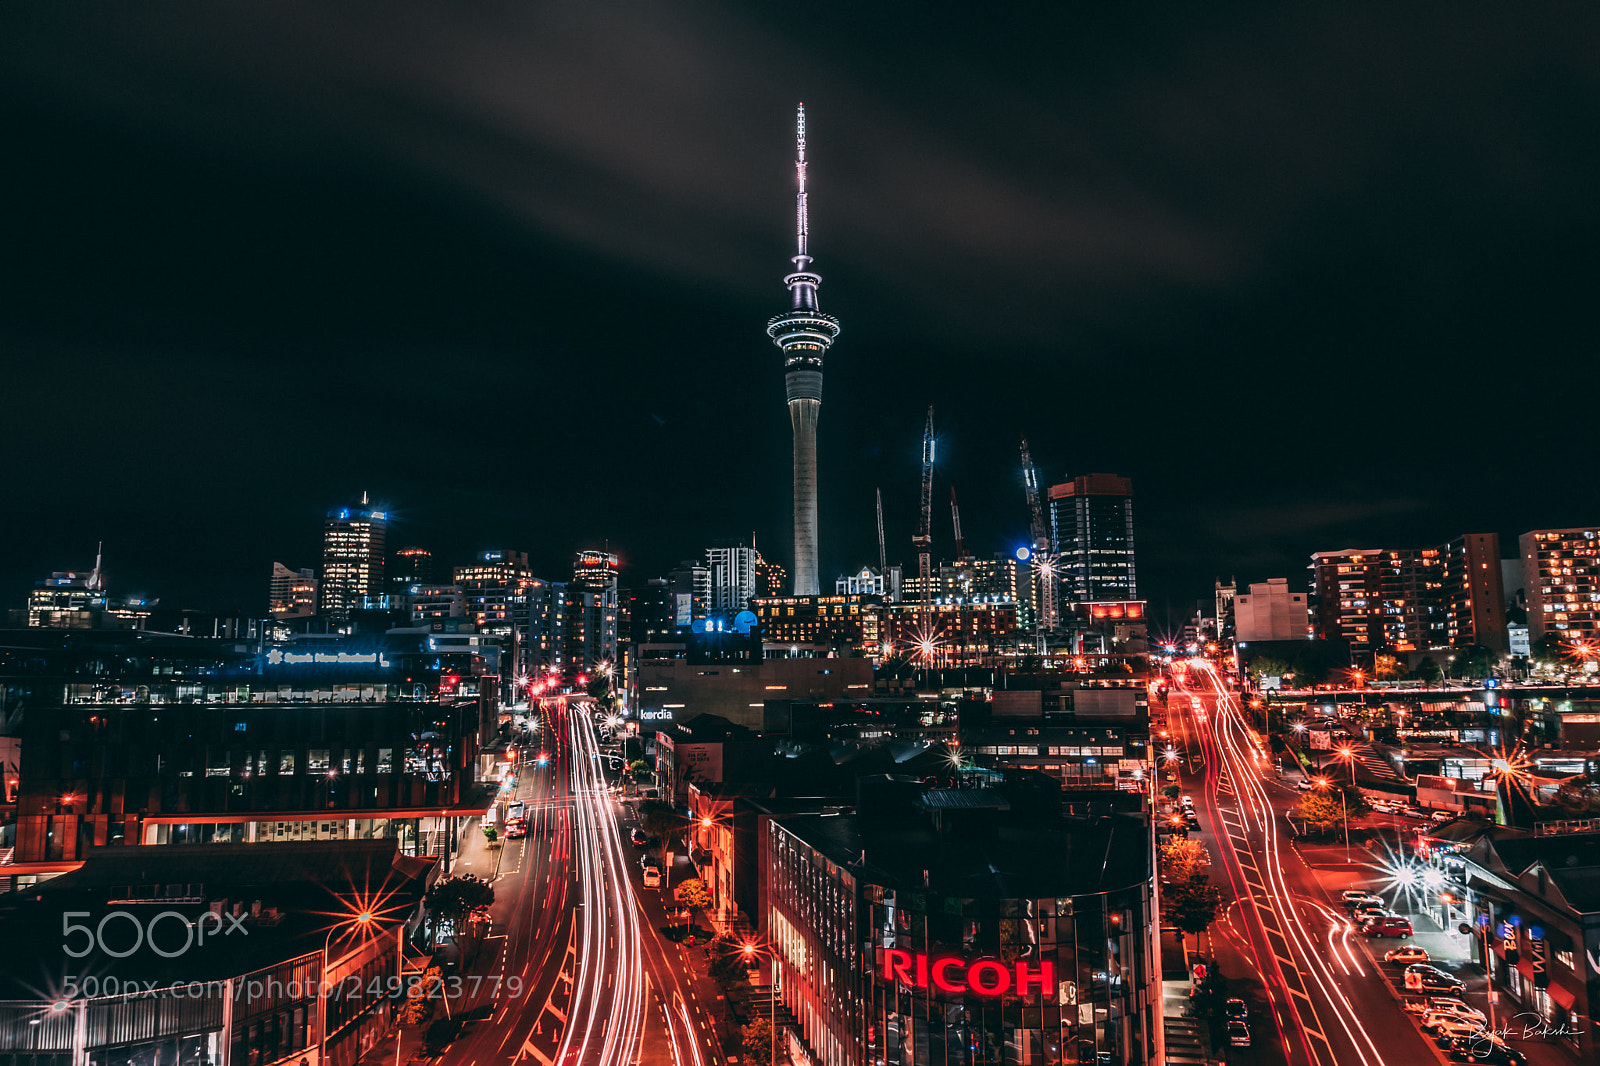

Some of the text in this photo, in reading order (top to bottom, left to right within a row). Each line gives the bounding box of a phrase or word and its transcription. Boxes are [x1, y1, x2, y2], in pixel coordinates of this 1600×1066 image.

[640, 708, 673, 720] kordia
[1503, 919, 1517, 951] Beer
[883, 948, 1054, 996] RICOH
